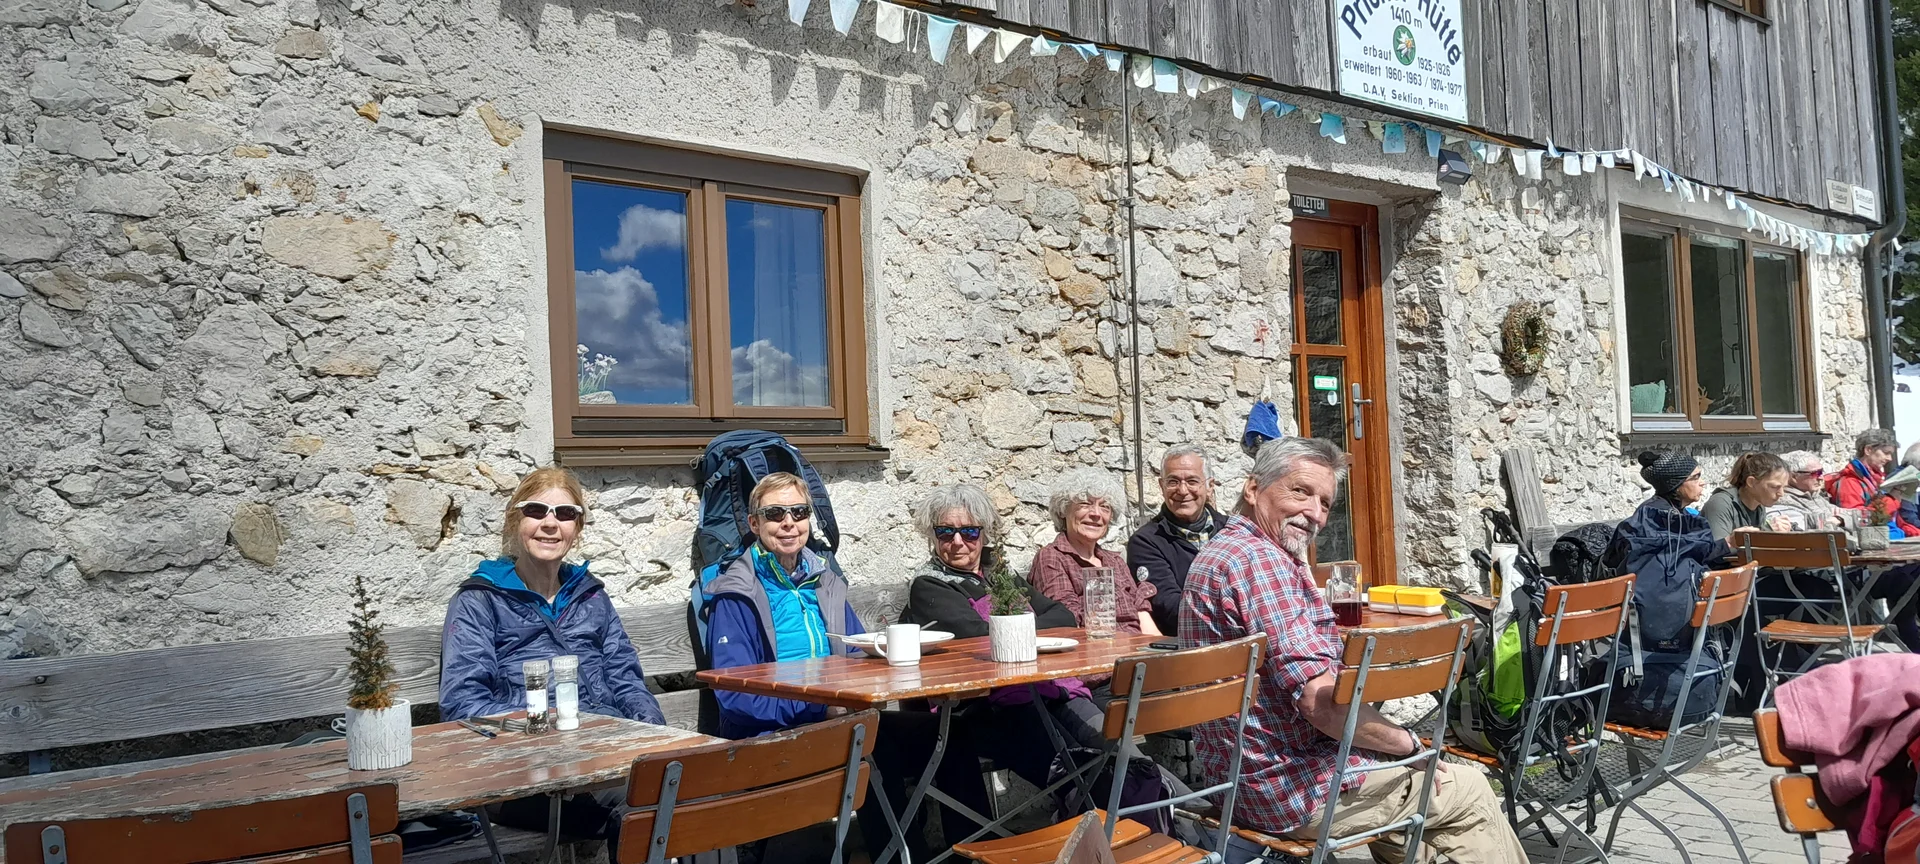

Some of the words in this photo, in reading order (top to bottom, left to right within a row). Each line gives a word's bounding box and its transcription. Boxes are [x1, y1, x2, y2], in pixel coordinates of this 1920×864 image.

[1390, 5, 1412, 25] 1410
[1413, 17, 1423, 29] m
[1363, 44, 1392, 61] erbaut
[1417, 56, 1451, 77] 1925-1926
[1344, 58, 1381, 77] erweitert
[1385, 65, 1423, 87] 1960-1963
[1430, 77, 1463, 97] 1974-1977
[1428, 97, 1449, 111] Prien
[1292, 194, 1325, 210] TOILETTEN
